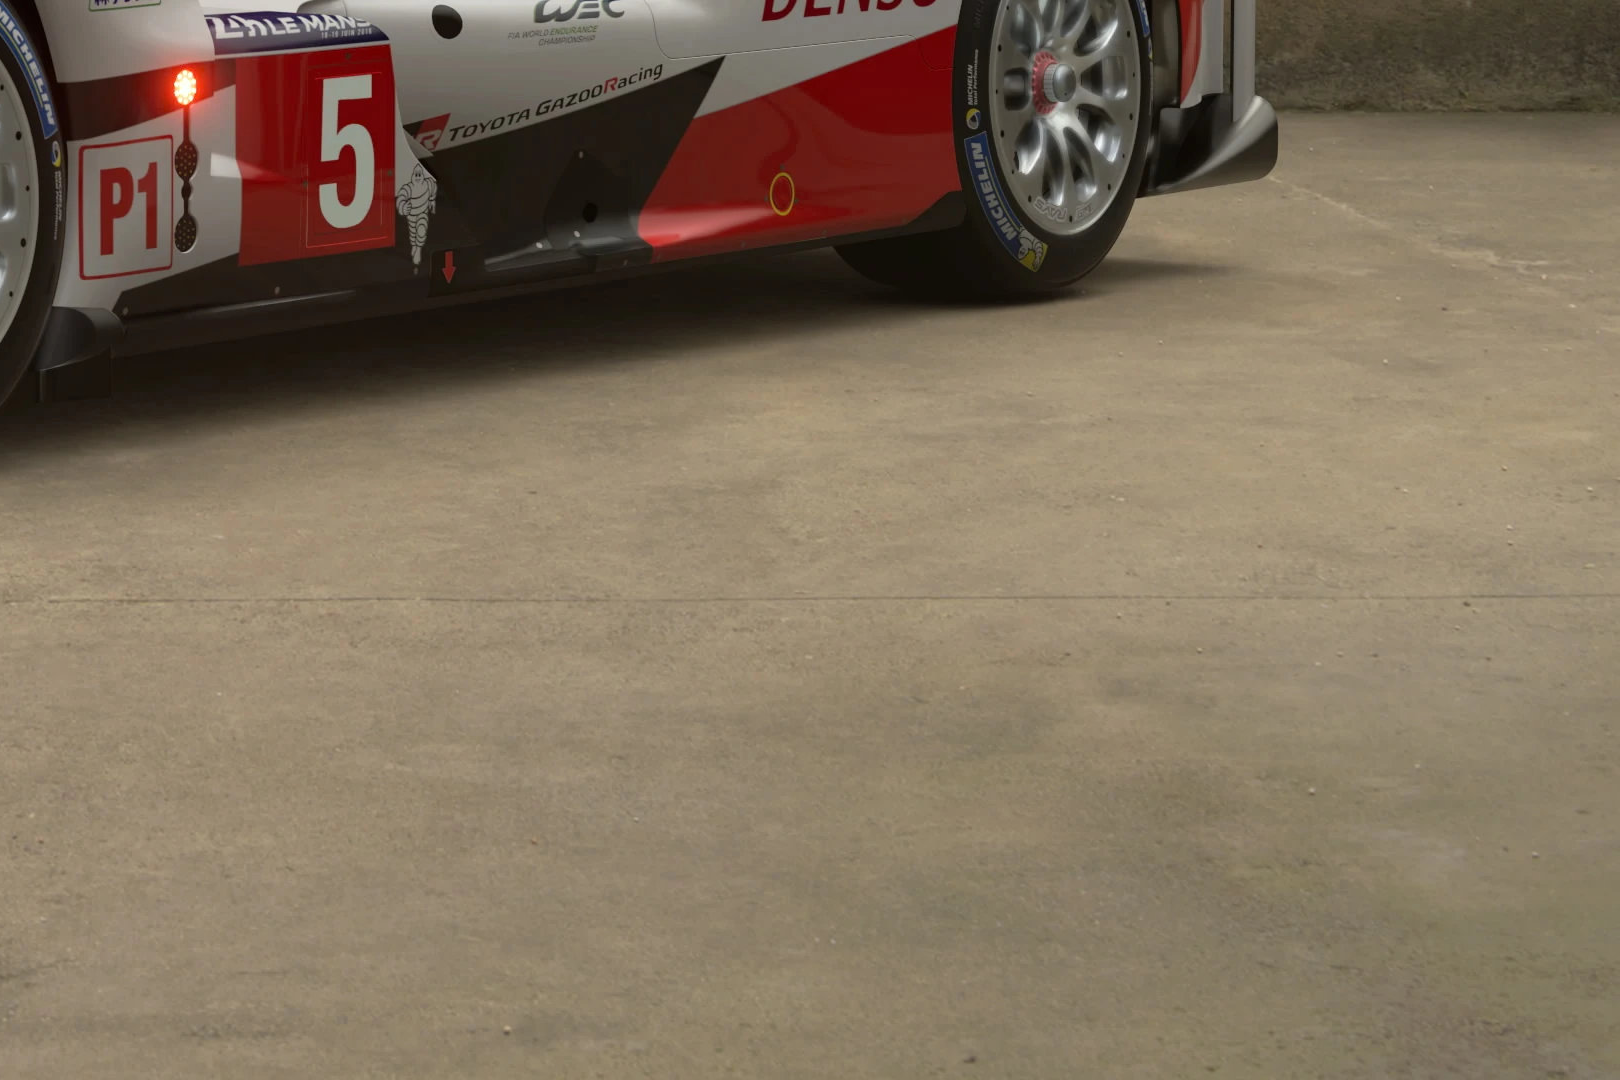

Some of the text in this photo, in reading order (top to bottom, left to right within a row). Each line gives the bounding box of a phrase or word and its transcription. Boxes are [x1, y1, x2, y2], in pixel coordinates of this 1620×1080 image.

[263, 17, 301, 35] LE
[297, 15, 372, 32] MANS
[522, 28, 549, 38] WORLD
[549, 25, 599, 36] ENDURANCE
[538, 35, 596, 46] CHAMPIONSHIP
[449, 108, 530, 142] TOYOTA
[318, 74, 376, 229] 5
[99, 161, 159, 256] P1
[970, 142, 1018, 241] MICHELIN
